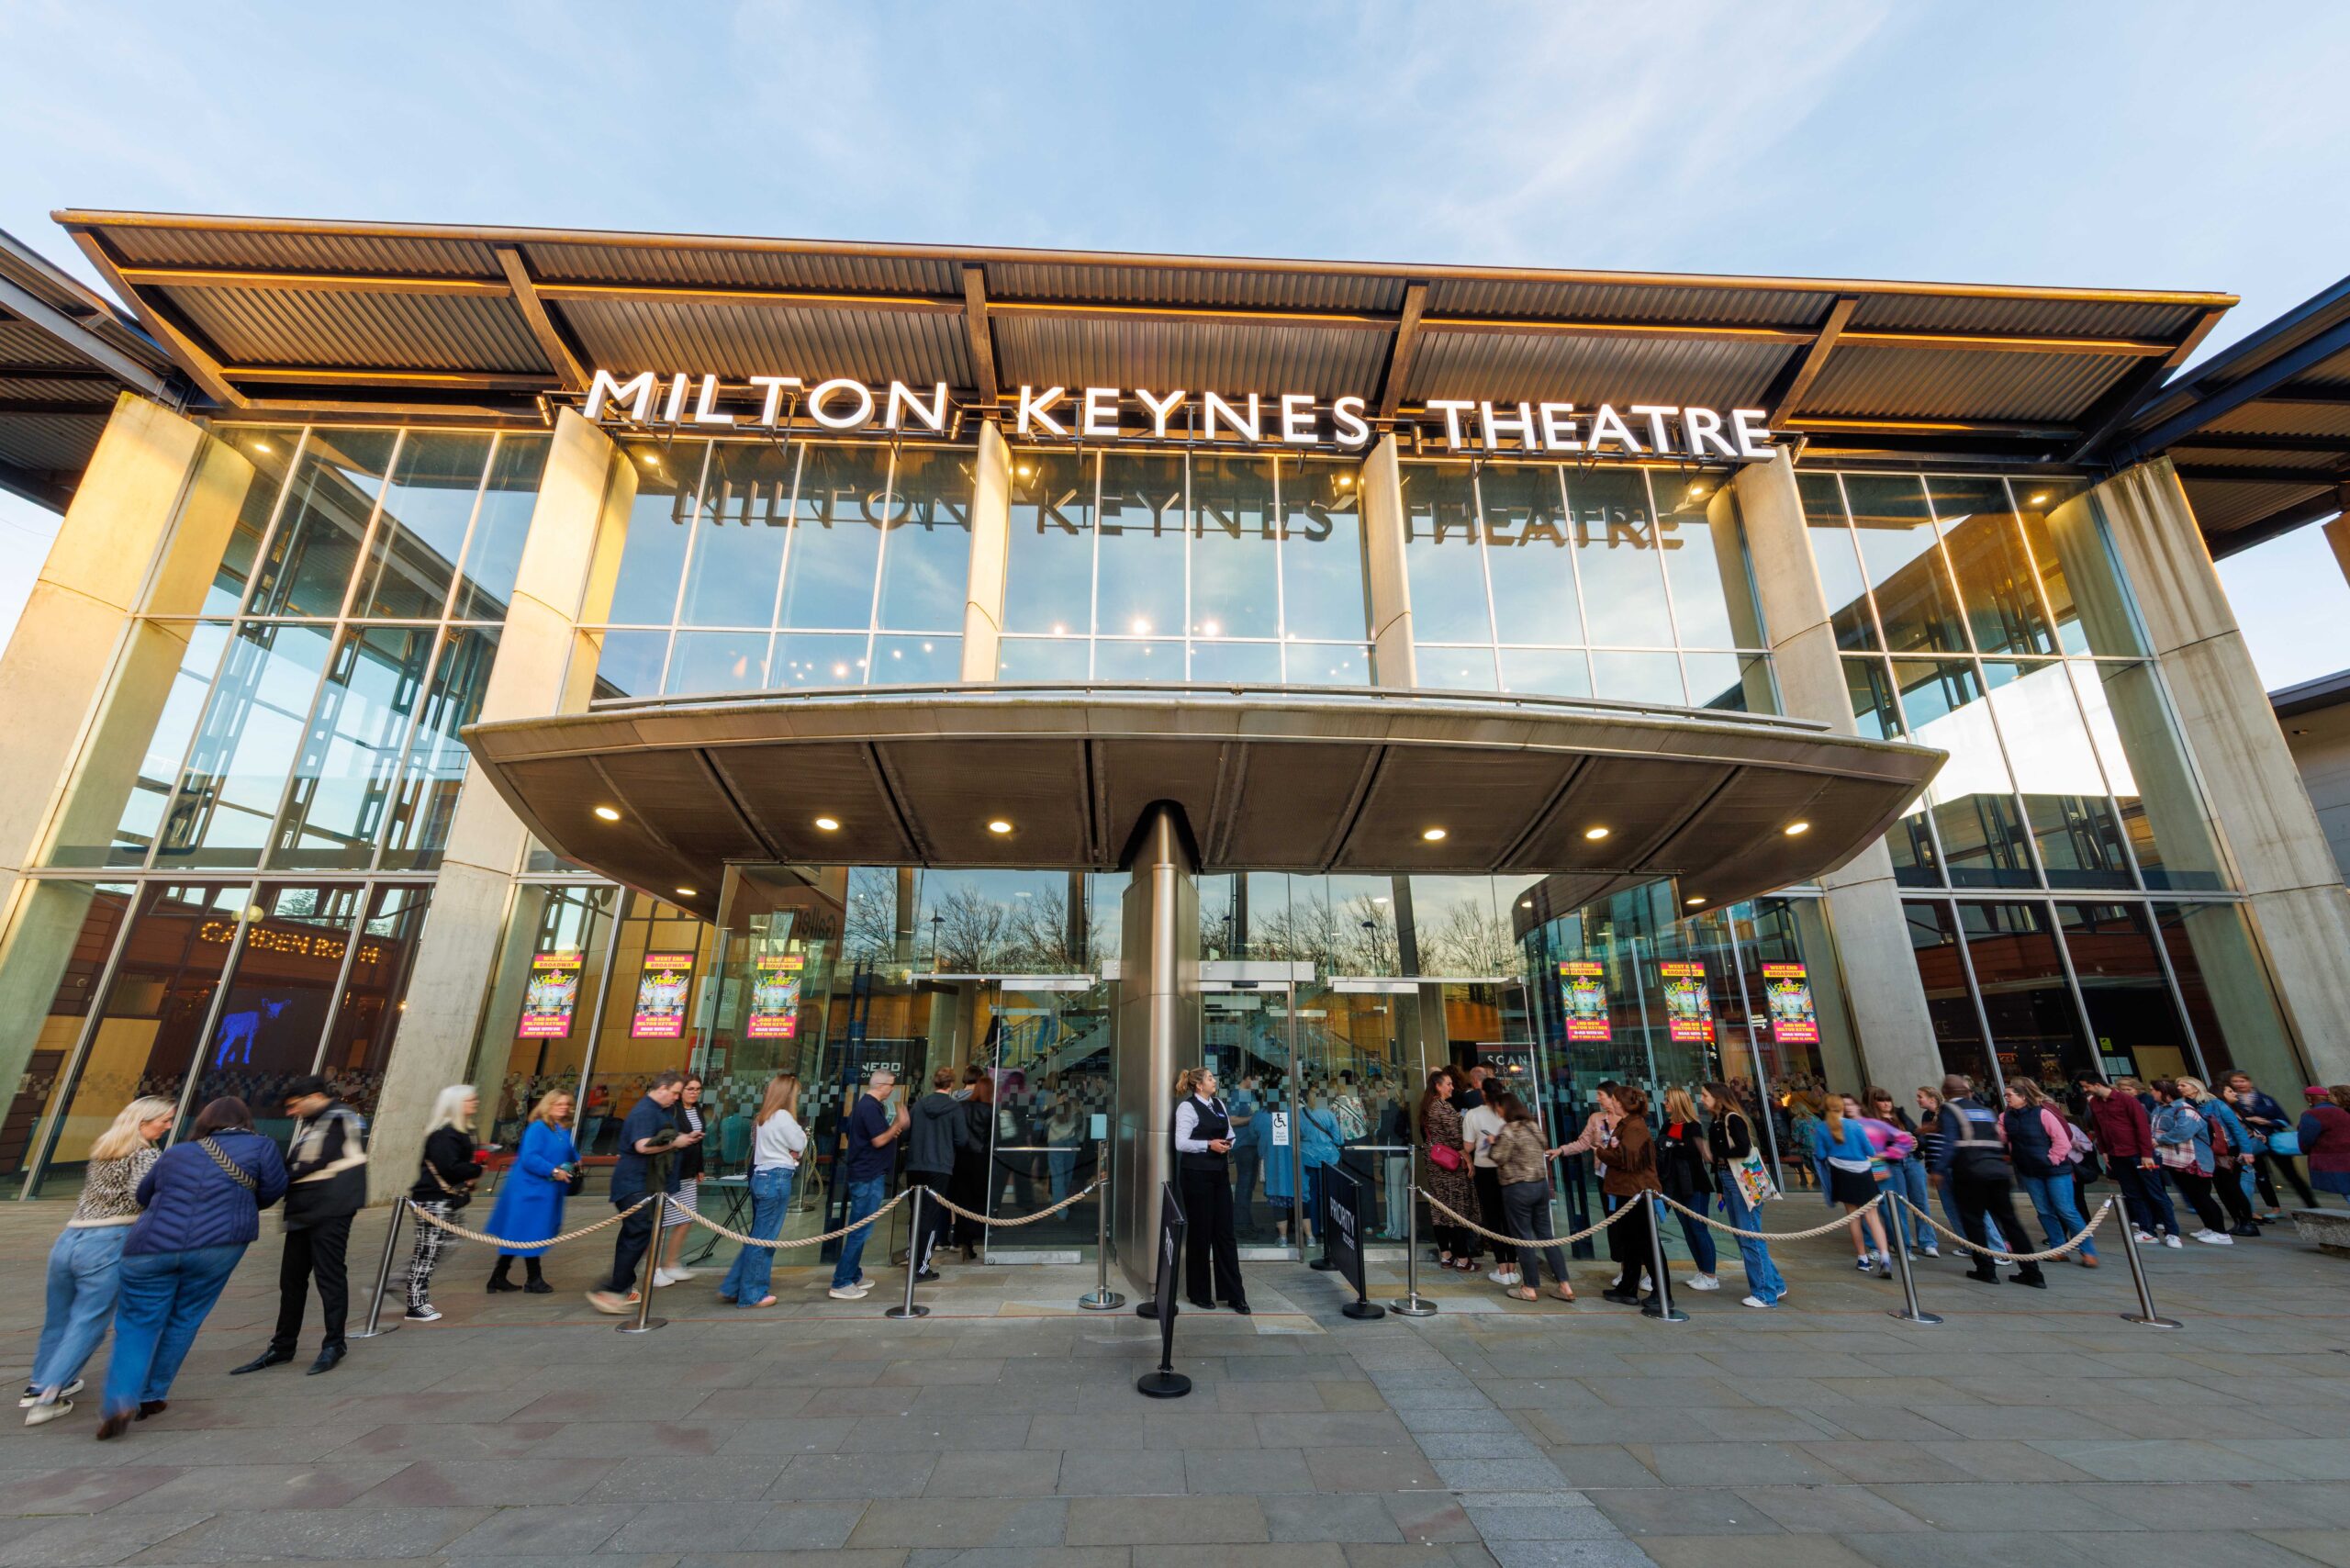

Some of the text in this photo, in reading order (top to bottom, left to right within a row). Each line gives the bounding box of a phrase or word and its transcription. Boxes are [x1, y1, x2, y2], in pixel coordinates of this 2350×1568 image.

[584, 369, 1778, 464] MILTON KEYNES THEATRE
[313, 937, 383, 965] ROM
[1487, 1054, 1528, 1066] SCAN
[1329, 1196, 1356, 1238] PRIORITY
